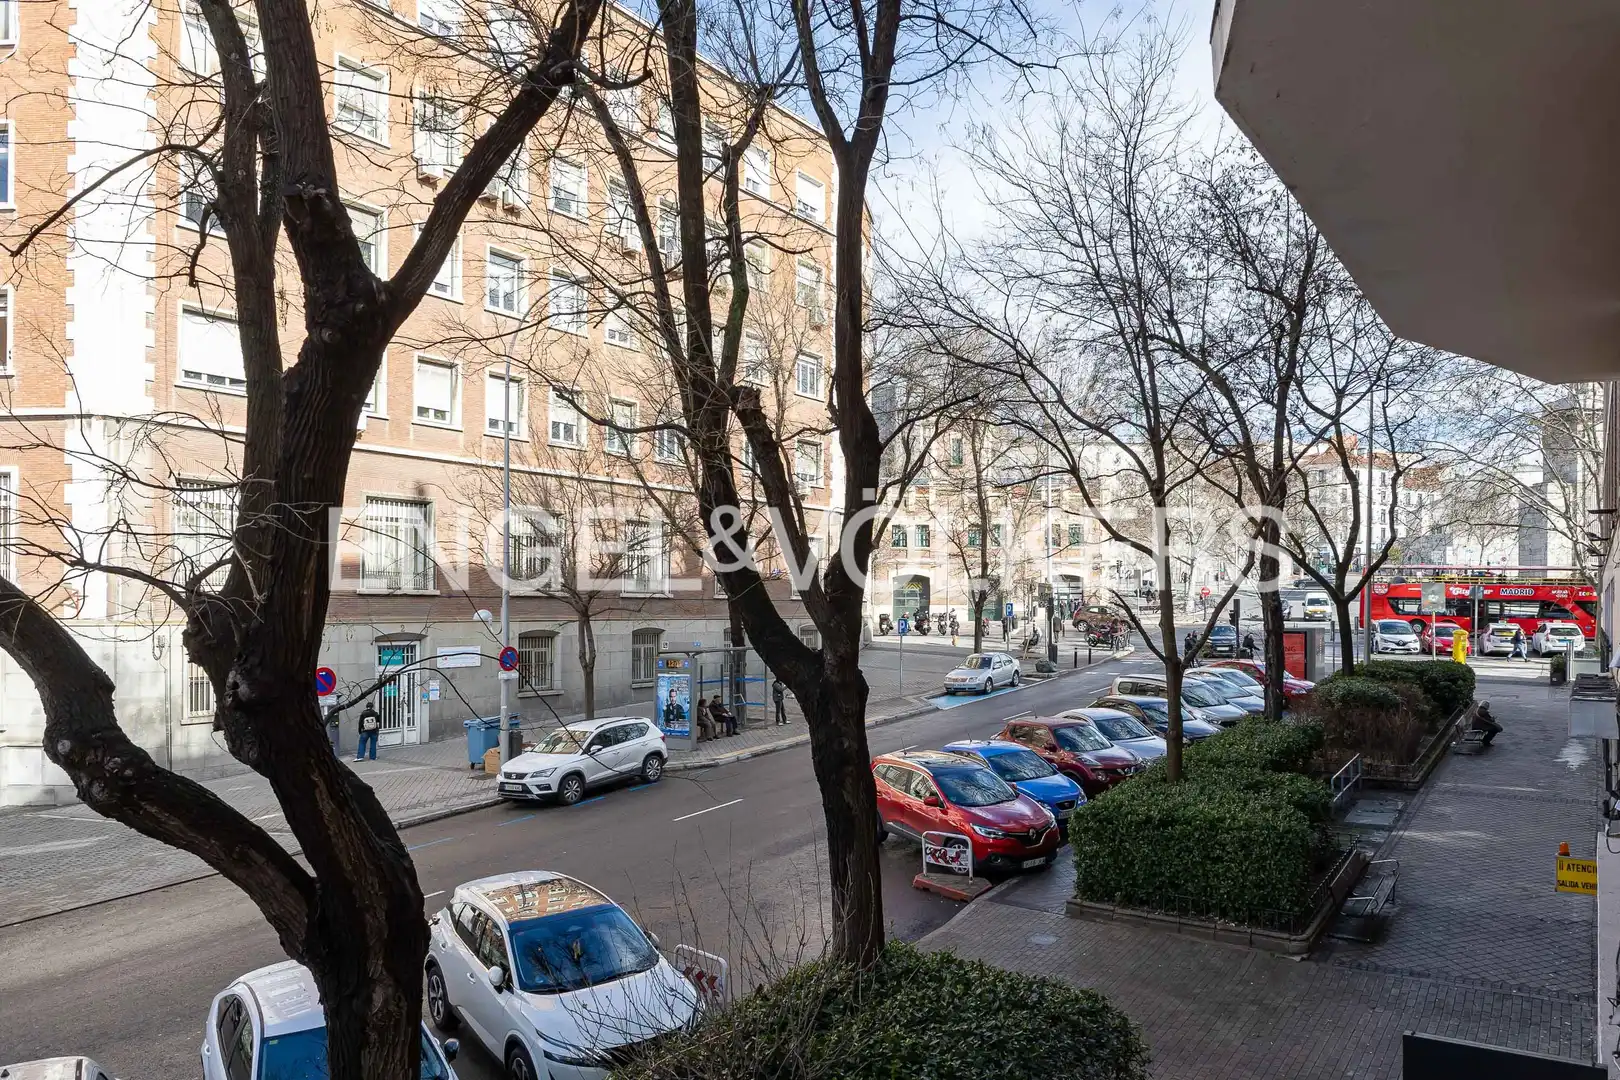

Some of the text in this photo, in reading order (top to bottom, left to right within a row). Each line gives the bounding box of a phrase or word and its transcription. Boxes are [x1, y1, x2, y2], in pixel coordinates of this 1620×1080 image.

[1500, 587, 1535, 596] MADRID
[400, 624, 406, 632] 2
[1557, 880, 1579, 888] SALIDA
